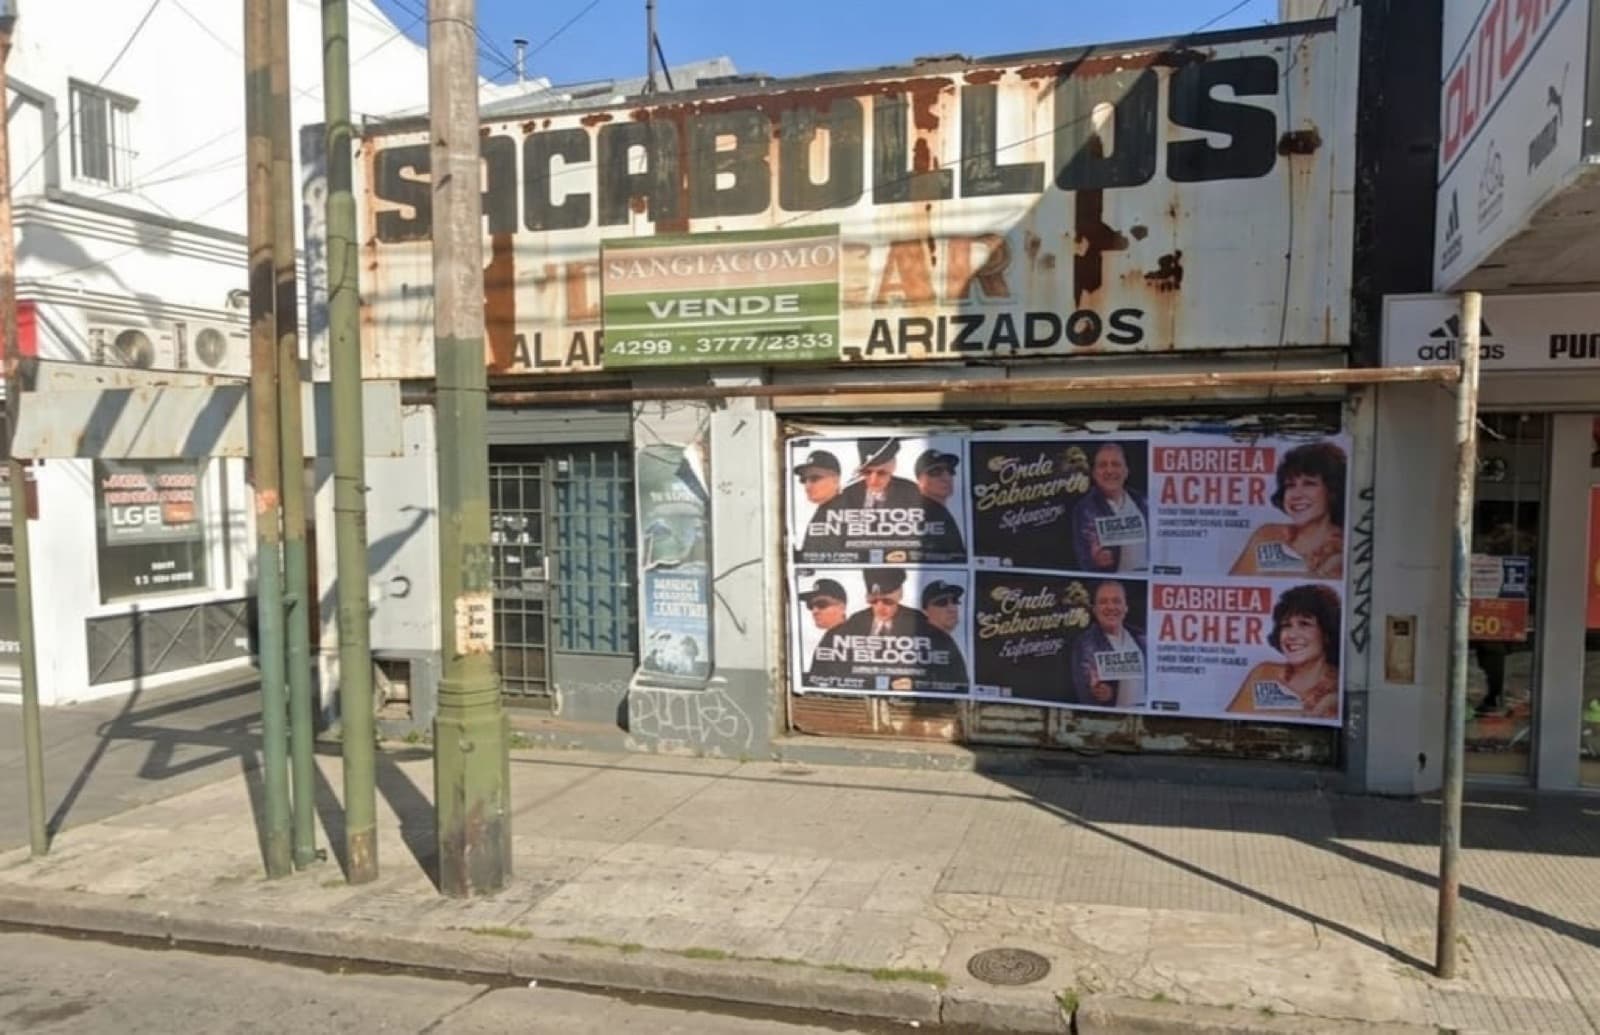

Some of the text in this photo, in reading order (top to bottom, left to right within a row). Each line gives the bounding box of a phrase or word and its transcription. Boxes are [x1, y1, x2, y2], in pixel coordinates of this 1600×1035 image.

[609, 245, 834, 281] SANGIACOMO
[646, 294, 800, 320] VENDE
[696, 332, 834, 353] 3777/2333
[1417, 339, 1505, 361] adias
[1161, 448, 1266, 473] GABRIELA
[1160, 475, 1267, 506] ACHER
[826, 508, 926, 523] NESTOR
[808, 521, 842, 537] EN
[1160, 586, 1264, 613] GABRIELA
[1158, 613, 1265, 645] ACHER
[814, 647, 848, 662] EN
[832, 635, 932, 651] NESTOR
